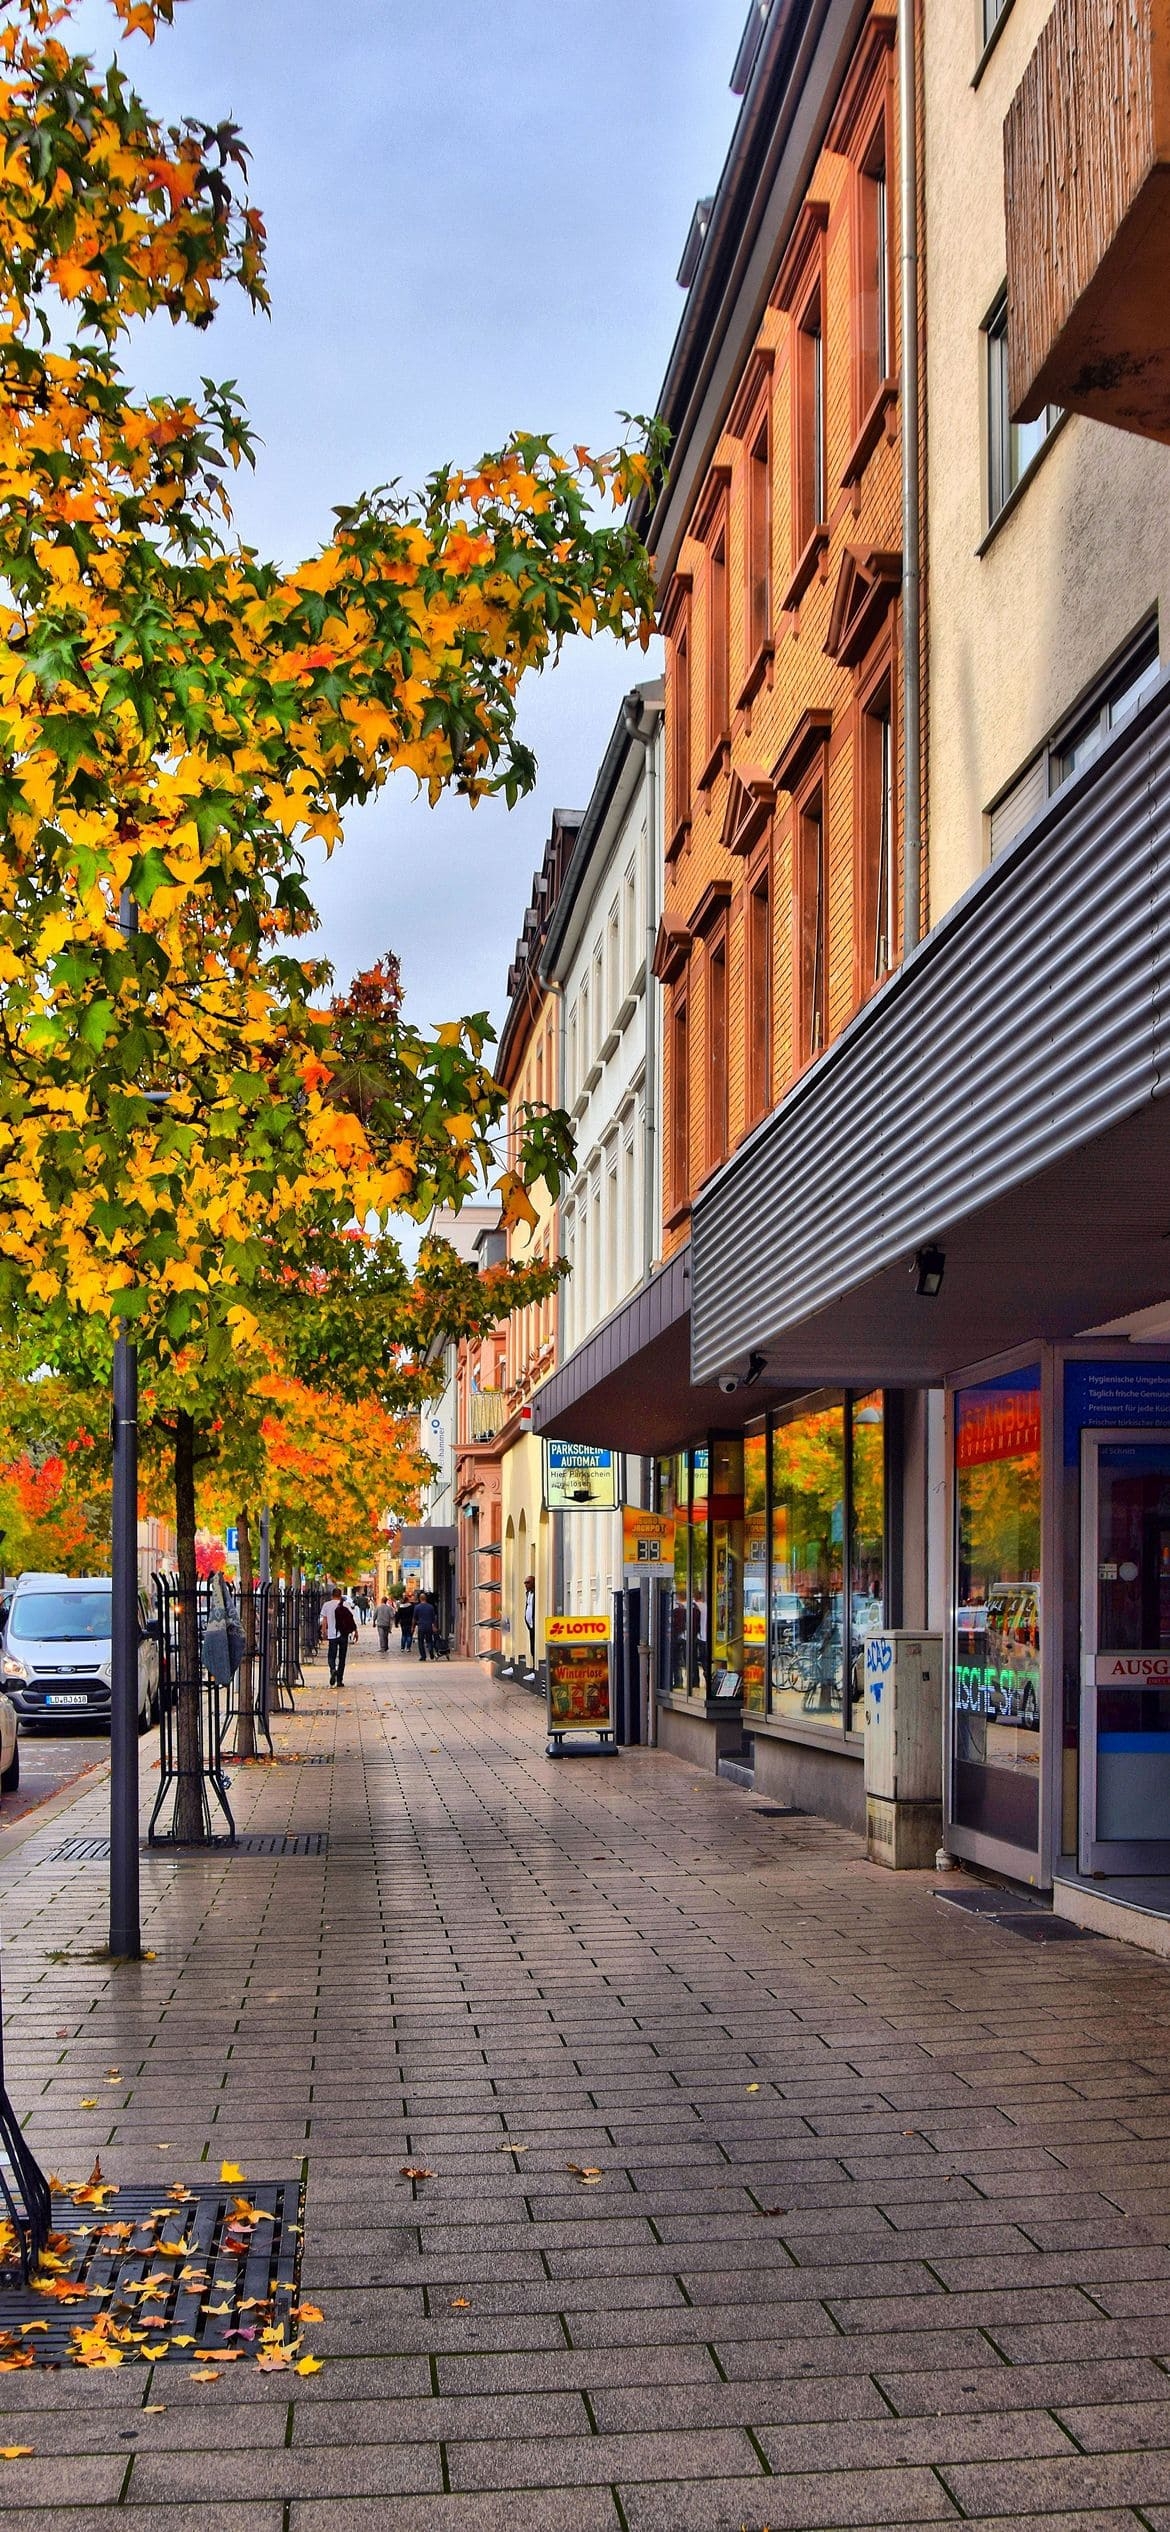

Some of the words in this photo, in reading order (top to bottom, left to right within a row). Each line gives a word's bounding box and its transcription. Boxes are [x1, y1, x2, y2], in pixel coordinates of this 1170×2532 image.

[1088, 1375, 1134, 1385] Hygienische
[1088, 1389, 1114, 1399] Täglich
[1088, 1404, 1123, 1412] Preiswert
[1137, 1404, 1154, 1413] jede
[960, 1426, 1039, 1459] SUPERMARKT
[560, 1455, 600, 1467] AUTOMAT
[569, 1470, 611, 1478] Parkschein
[638, 1540, 660, 1560] 39
[566, 1622, 606, 1634] LOTTO
[555, 1665, 603, 1680] Winterlose
[1111, 1659, 1169, 1675] AUSG
